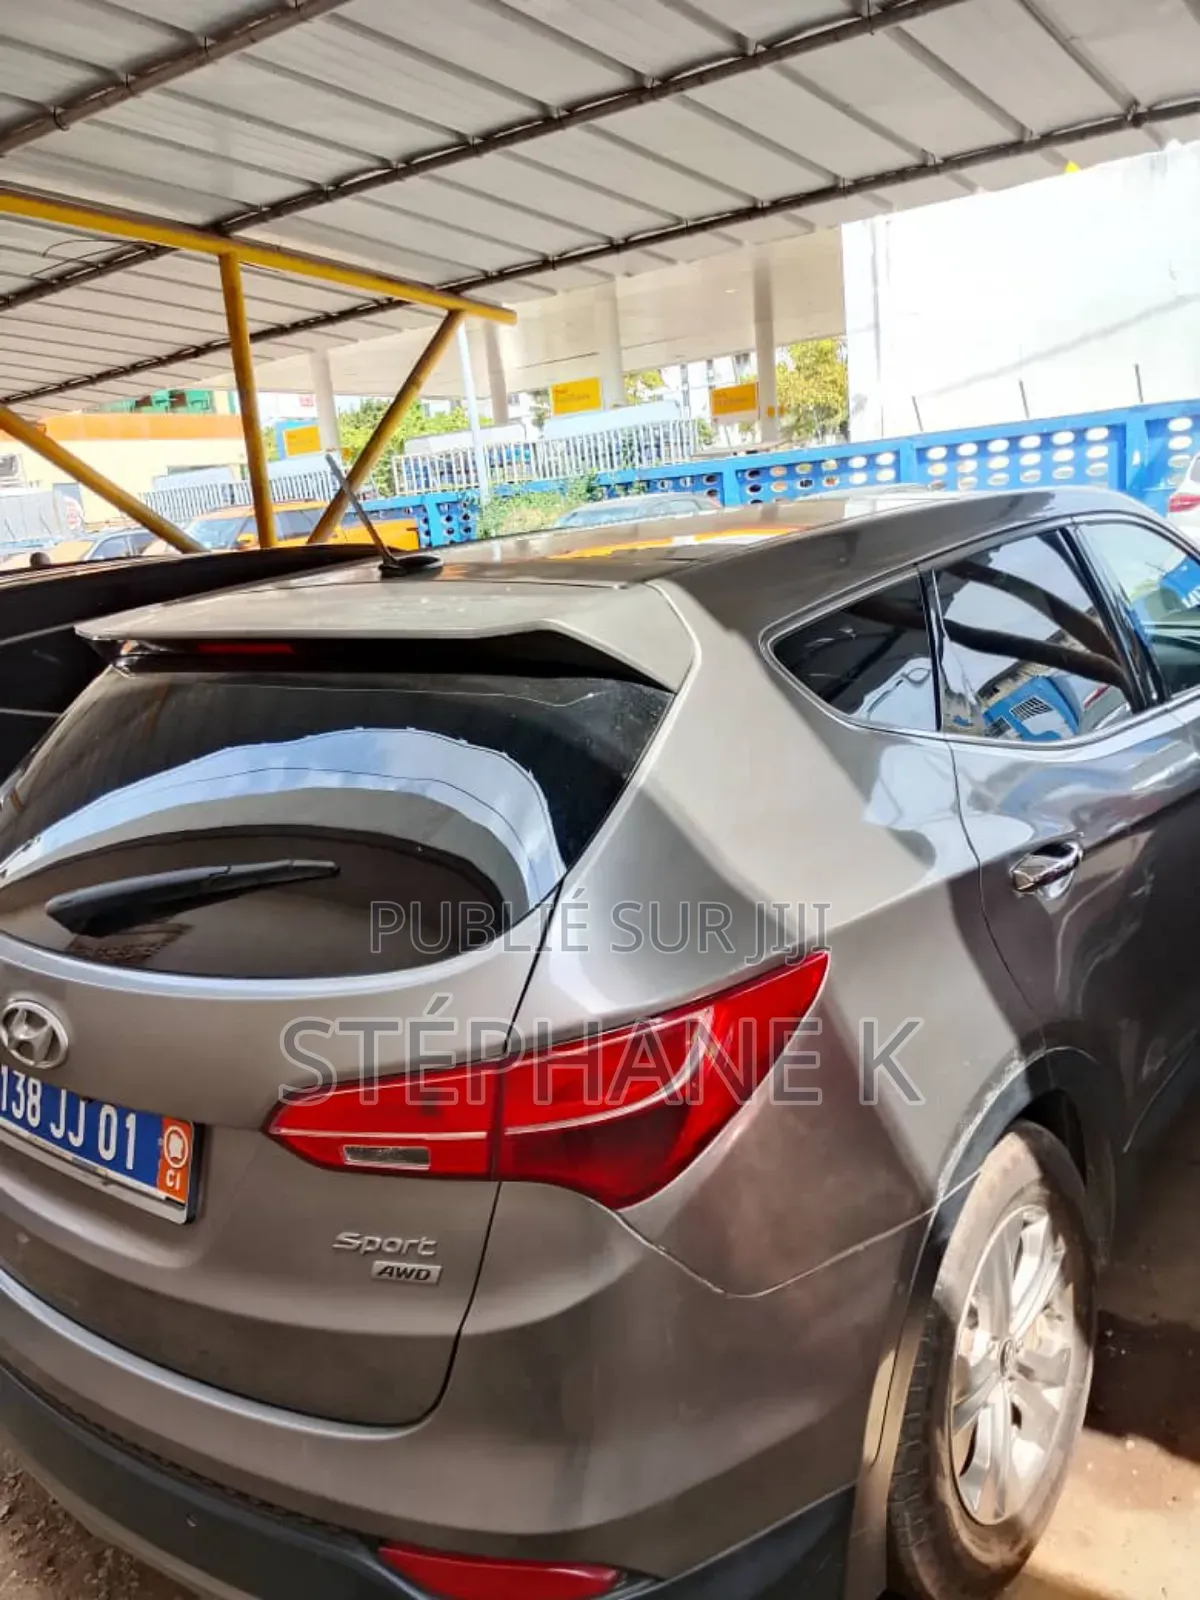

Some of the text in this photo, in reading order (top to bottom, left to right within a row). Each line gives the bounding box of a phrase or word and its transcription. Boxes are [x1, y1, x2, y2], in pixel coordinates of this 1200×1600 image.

[0, 1064, 136, 1170] 138 JJ 01
[166, 1169, 181, 1190] CI
[332, 1232, 438, 1255] Sport
[377, 1265, 431, 1280] AWD
